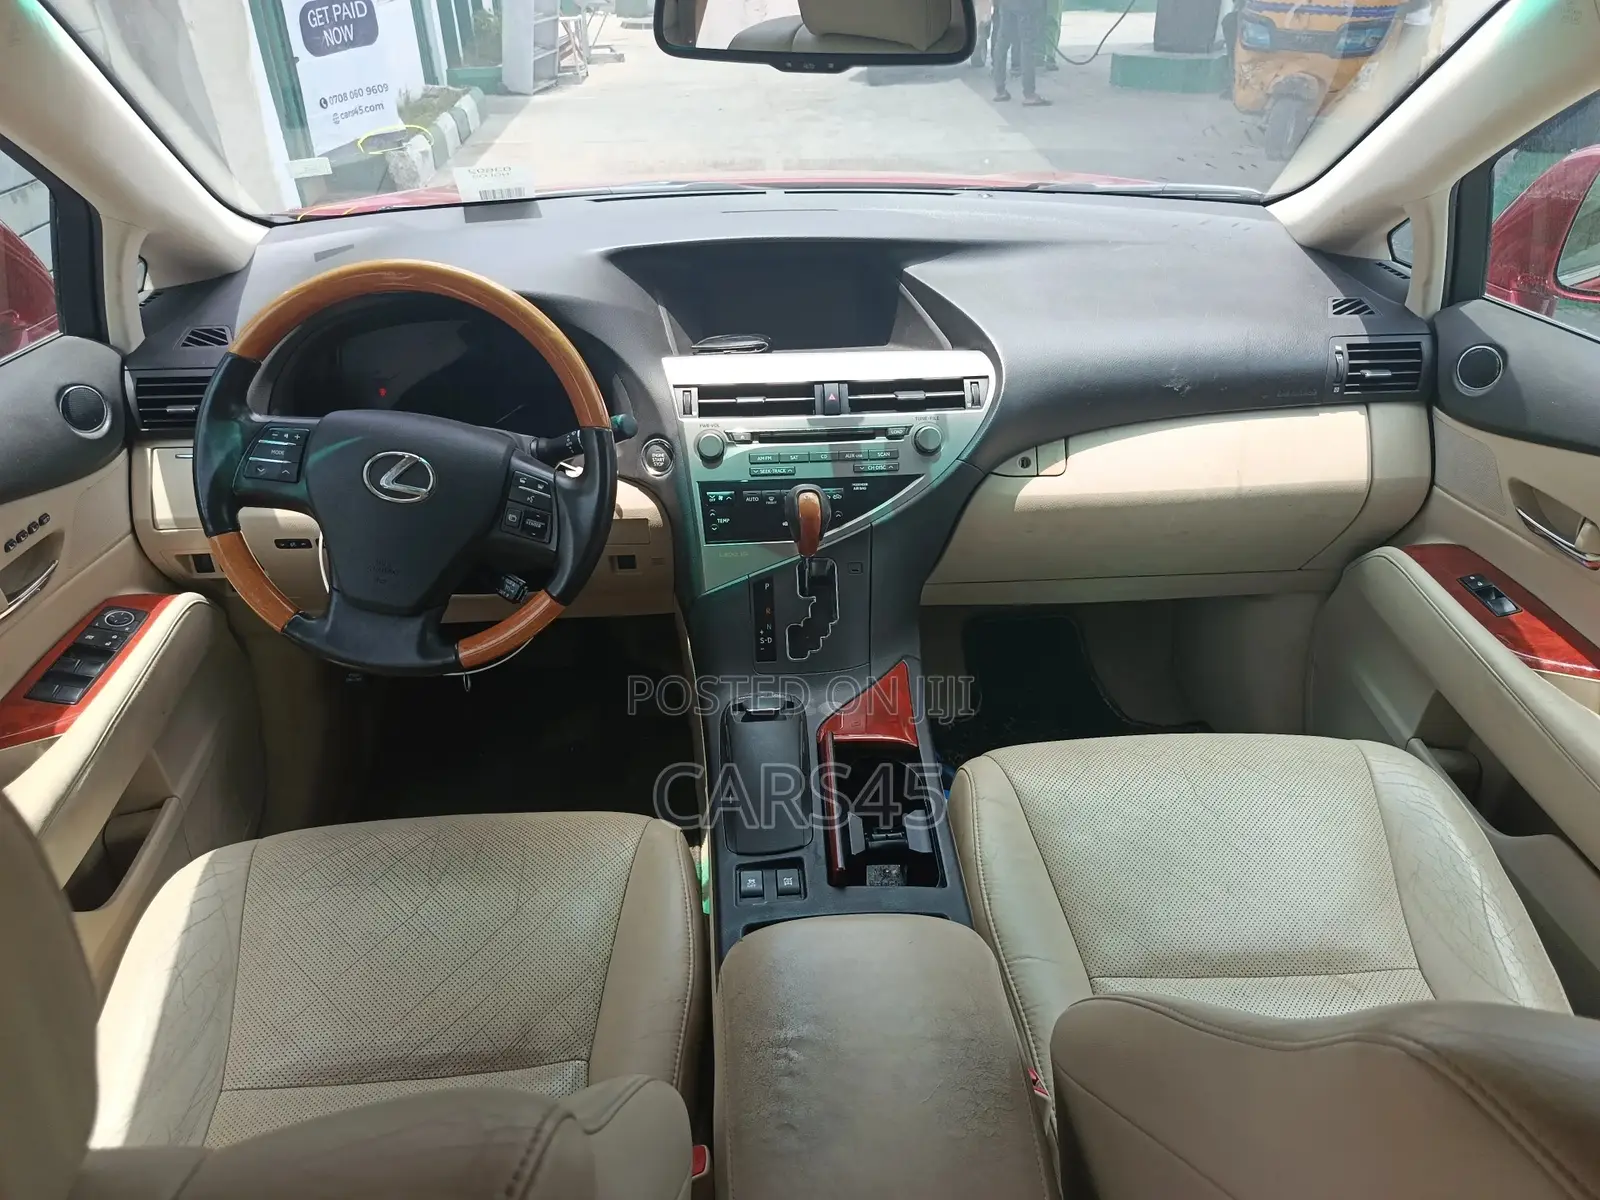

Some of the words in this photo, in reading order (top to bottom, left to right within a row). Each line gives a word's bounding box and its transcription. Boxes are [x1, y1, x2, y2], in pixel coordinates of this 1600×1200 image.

[307, 6, 330, 28] GET
[332, 0, 367, 22] PAID
[323, 23, 354, 47] NOW
[328, 92, 349, 105] 0708
[365, 82, 389, 96] 9609
[339, 102, 385, 120] cars45.com
[765, 607, 771, 615] R
